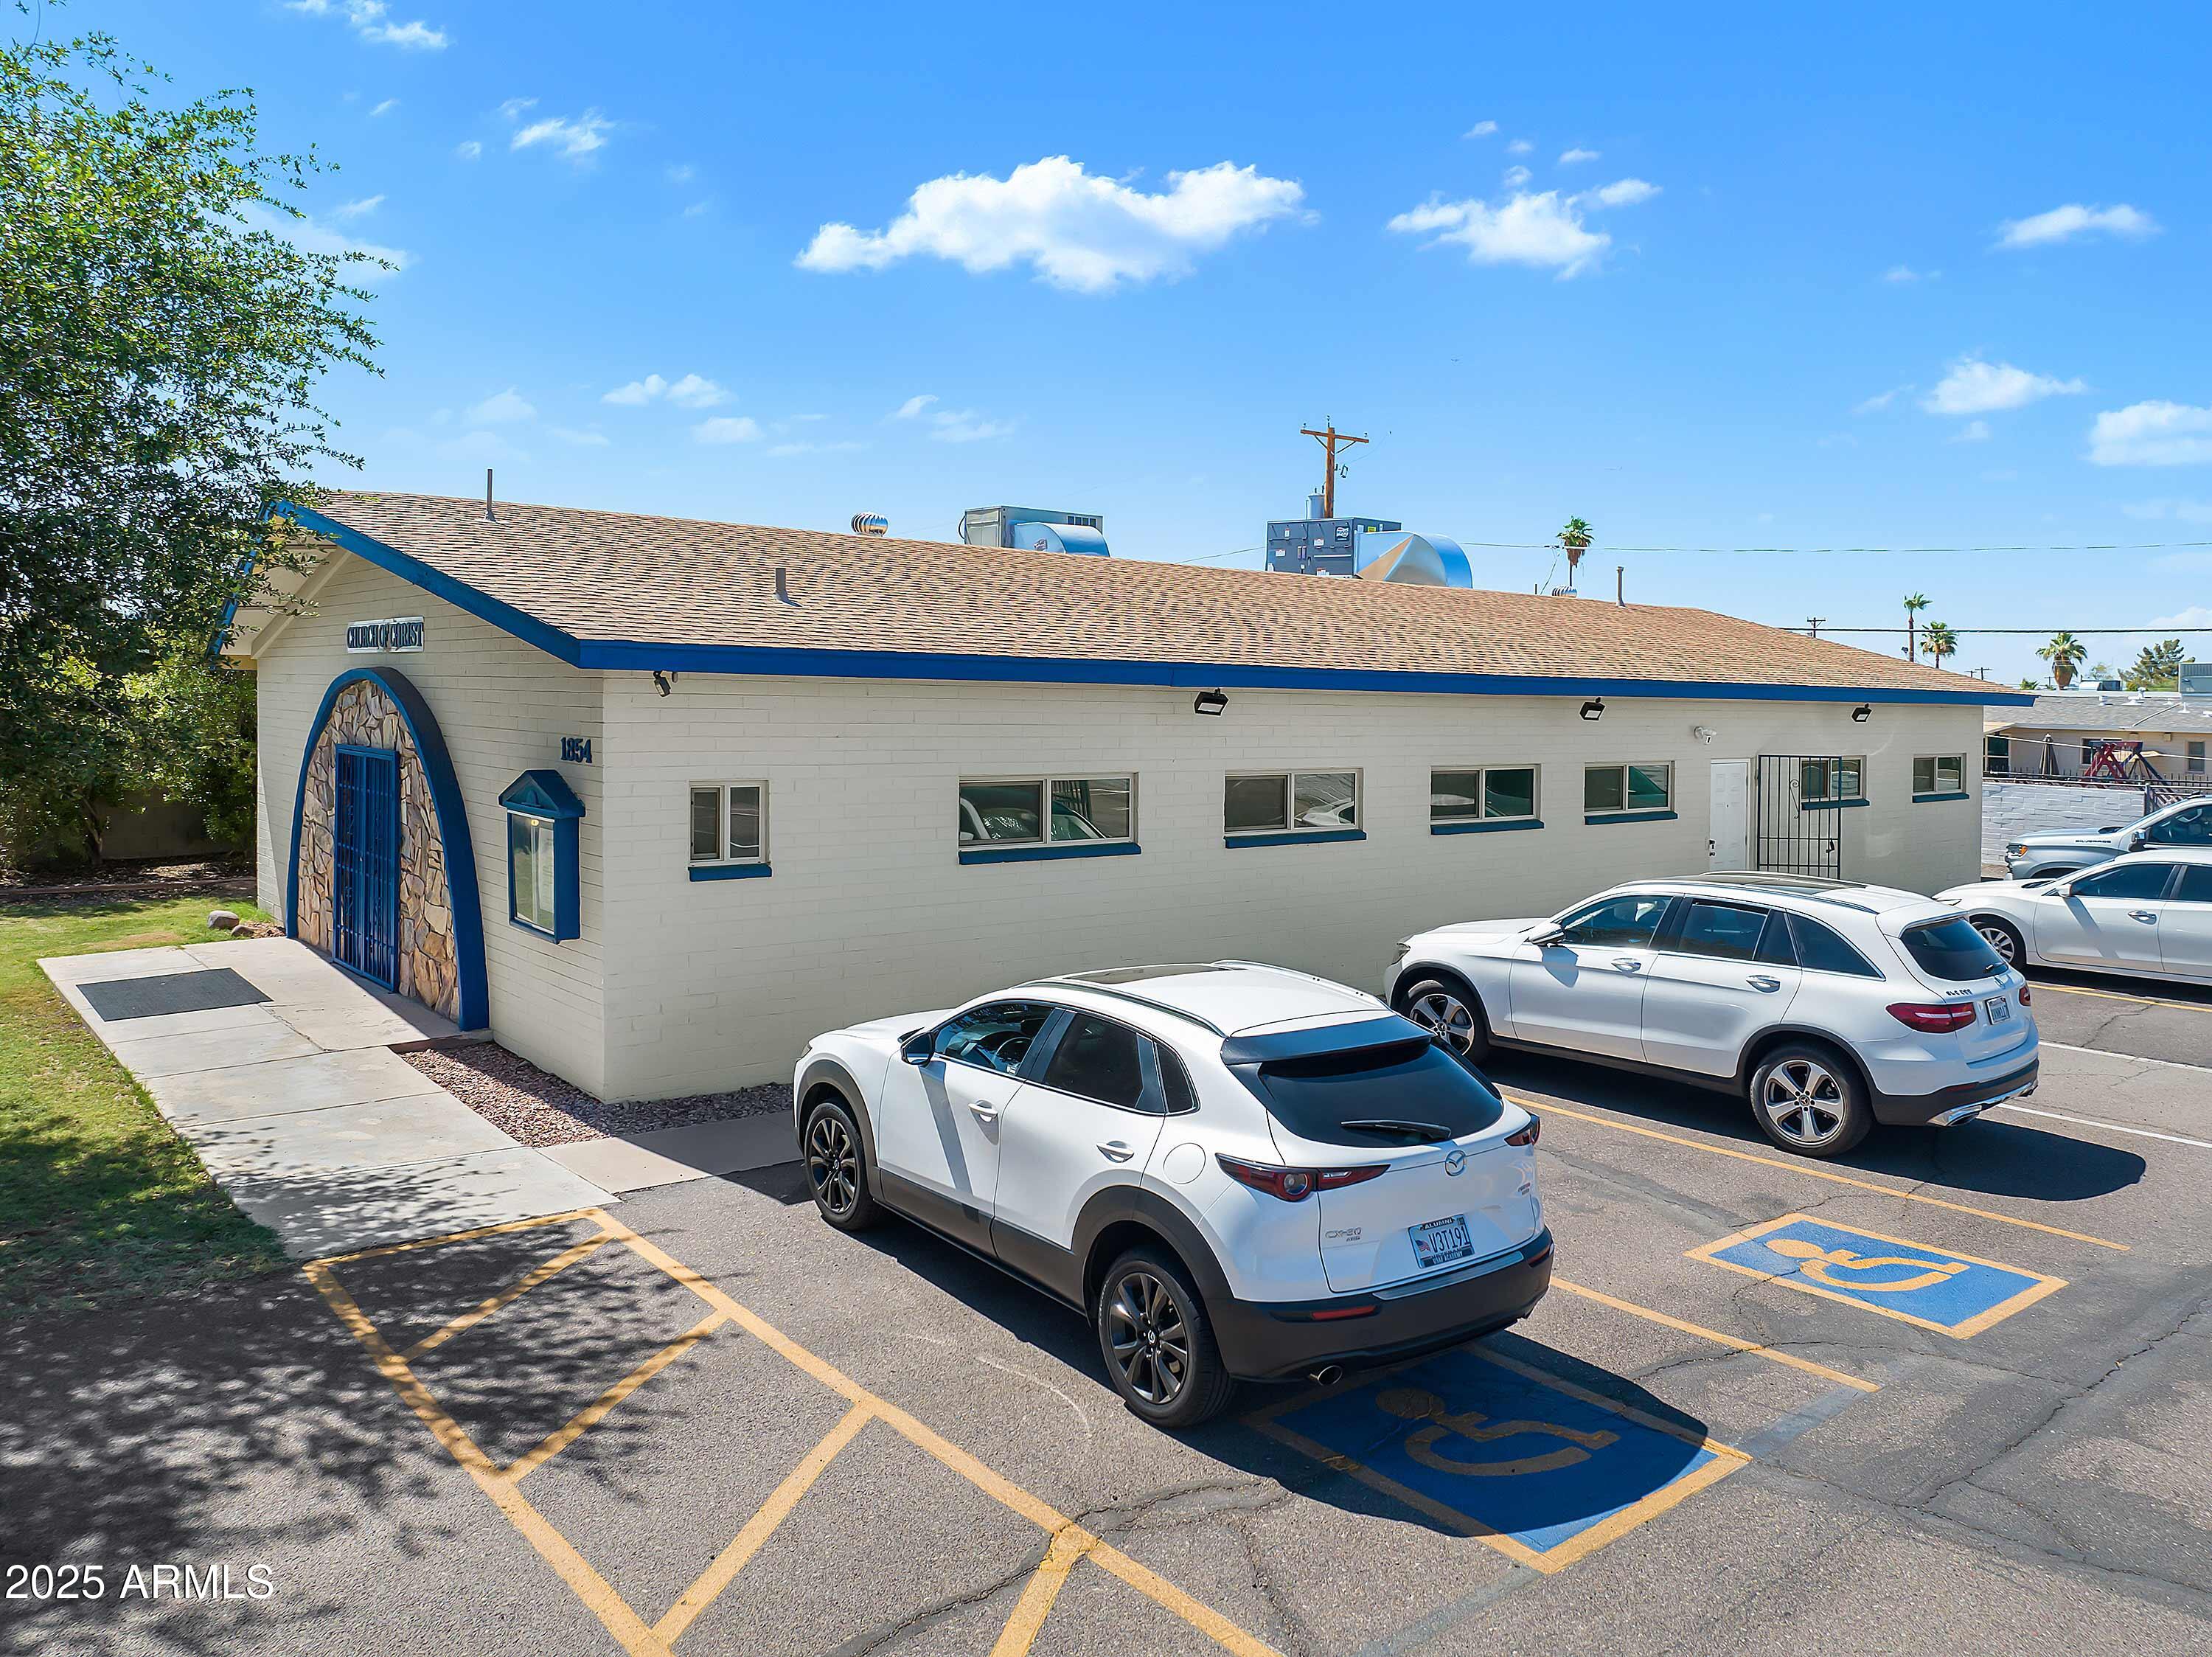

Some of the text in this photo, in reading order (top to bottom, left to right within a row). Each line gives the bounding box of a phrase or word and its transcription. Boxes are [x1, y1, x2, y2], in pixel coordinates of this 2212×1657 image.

[347, 622, 424, 648] CHURCH OF CHRIST
[560, 737, 592, 764] 1854
[1425, 1217, 1453, 1229] ALUMNI
[1428, 1226, 1471, 1253] V3T191
